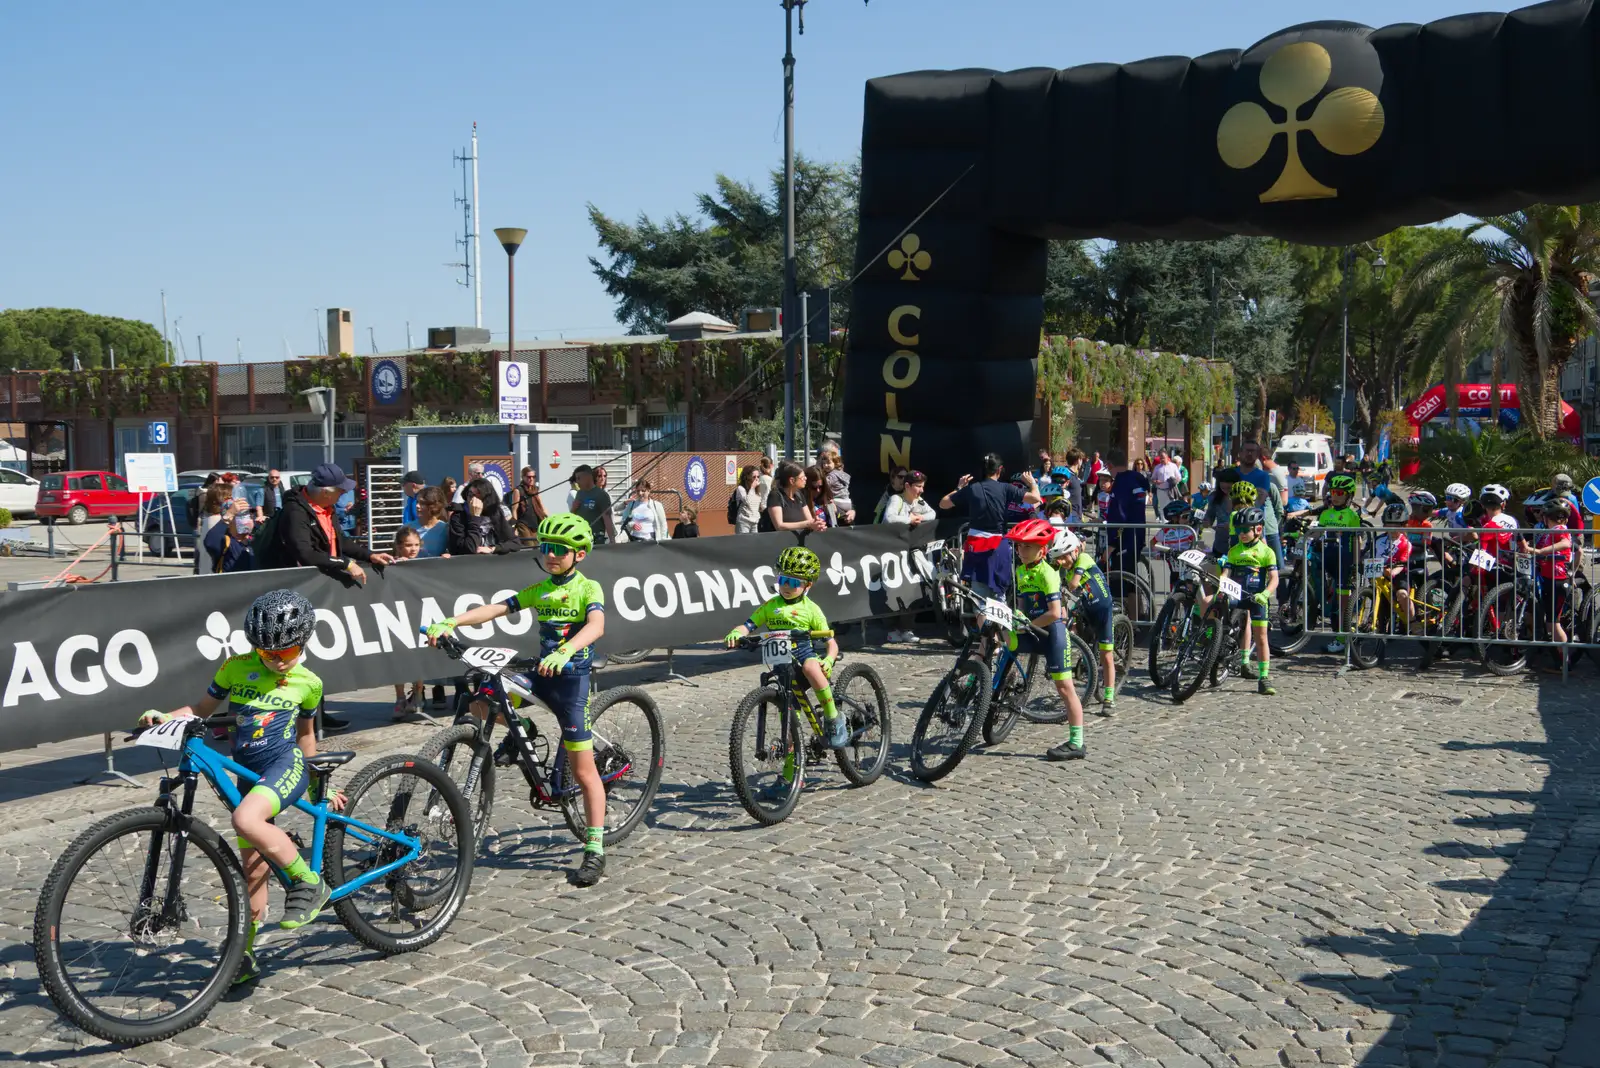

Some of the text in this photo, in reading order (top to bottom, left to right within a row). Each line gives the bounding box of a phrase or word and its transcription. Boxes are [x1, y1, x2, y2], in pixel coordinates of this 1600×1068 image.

[1468, 389, 1507, 401] COTI
[1411, 395, 1442, 419] COATI
[155, 424, 167, 442] 3
[1183, 551, 1203, 562] 107
[612, 565, 809, 622] COLNAG
[1222, 580, 1240, 596] 106
[536, 608, 579, 618] SARNICO
[989, 605, 1011, 623] 104
[299, 588, 534, 664] OLNAGO
[472, 647, 506, 667] 102
[764, 640, 788, 657] 103
[2, 628, 160, 708] AGO
[231, 686, 294, 710] SARNICO
[148, 719, 187, 737] 101
[462, 765, 480, 800] ROCKSHOX
[232, 876, 247, 935] ROCKET
[395, 929, 435, 945] ROCKET
